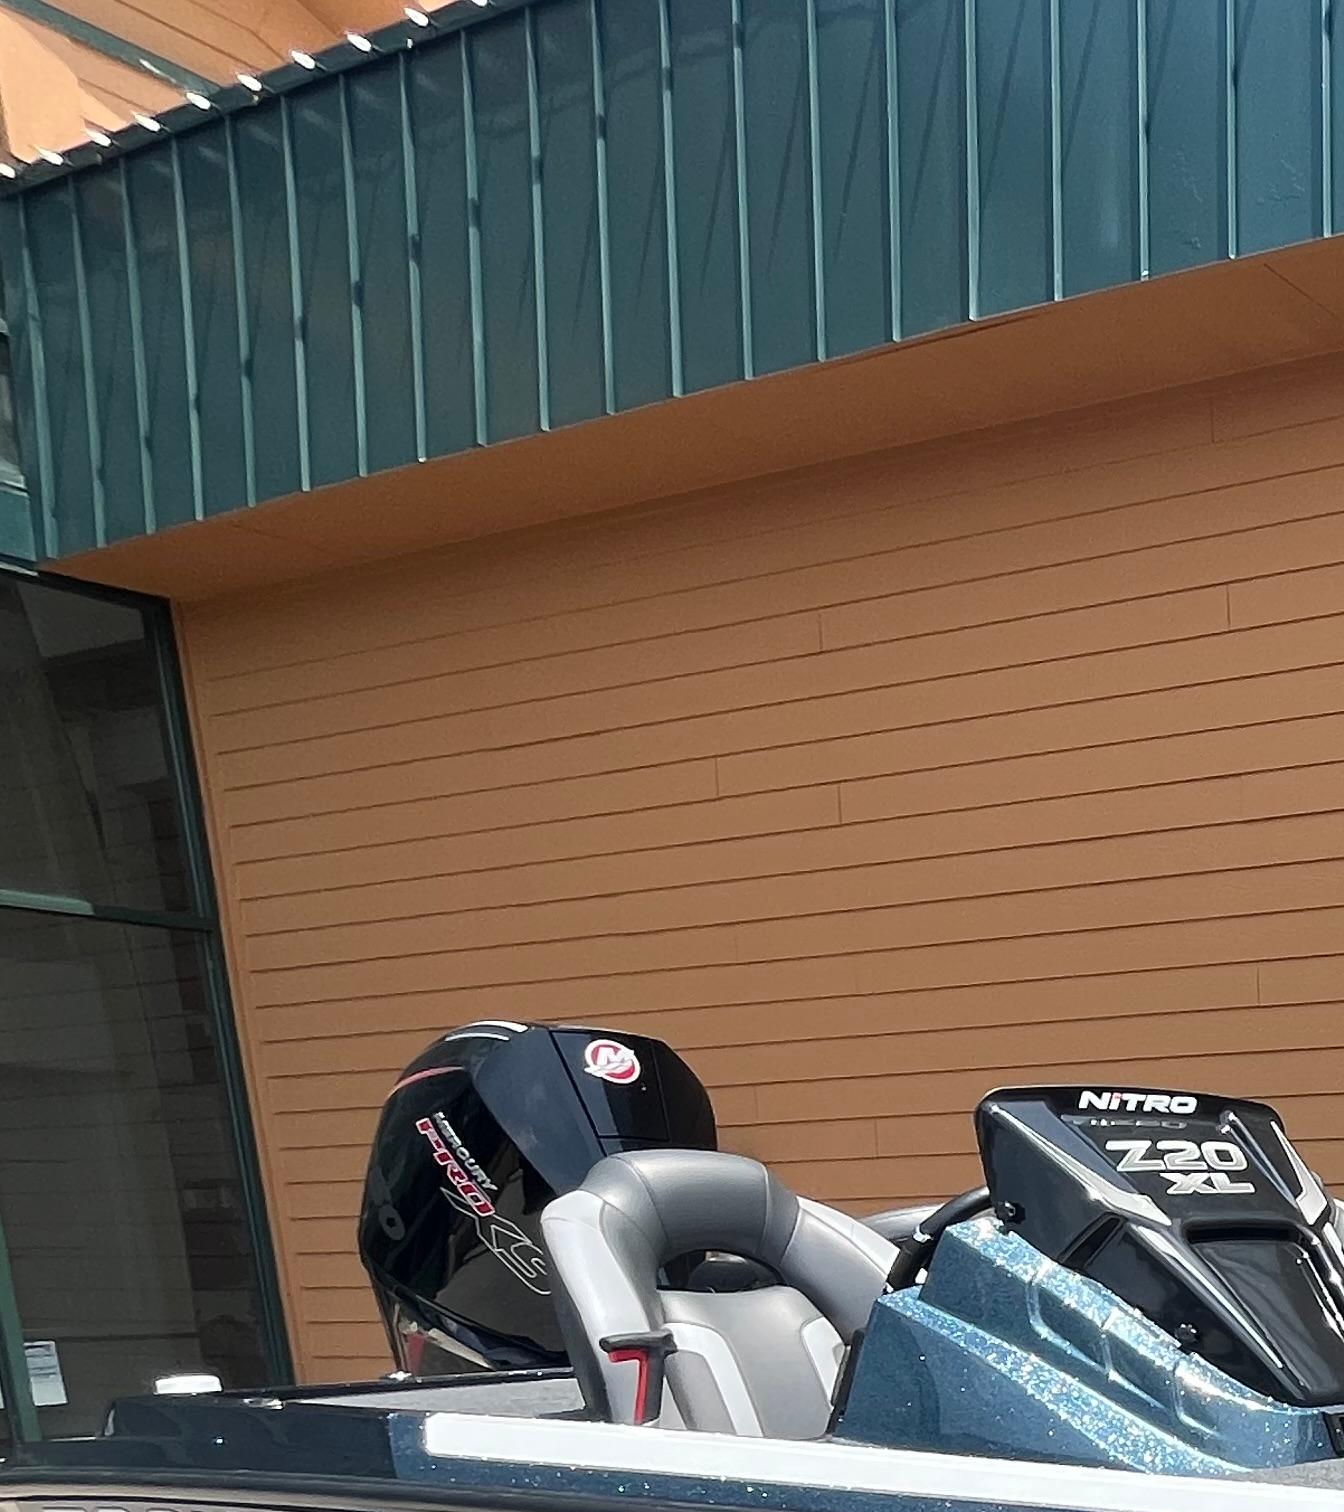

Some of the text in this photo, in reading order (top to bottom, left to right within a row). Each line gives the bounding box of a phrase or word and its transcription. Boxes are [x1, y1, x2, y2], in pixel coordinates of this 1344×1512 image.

[416, 1117, 496, 1217] PRO
[432, 1111, 498, 1191] MERCURY
[1105, 1140, 1248, 1171] Z20
[1160, 1172, 1255, 1195] XL
